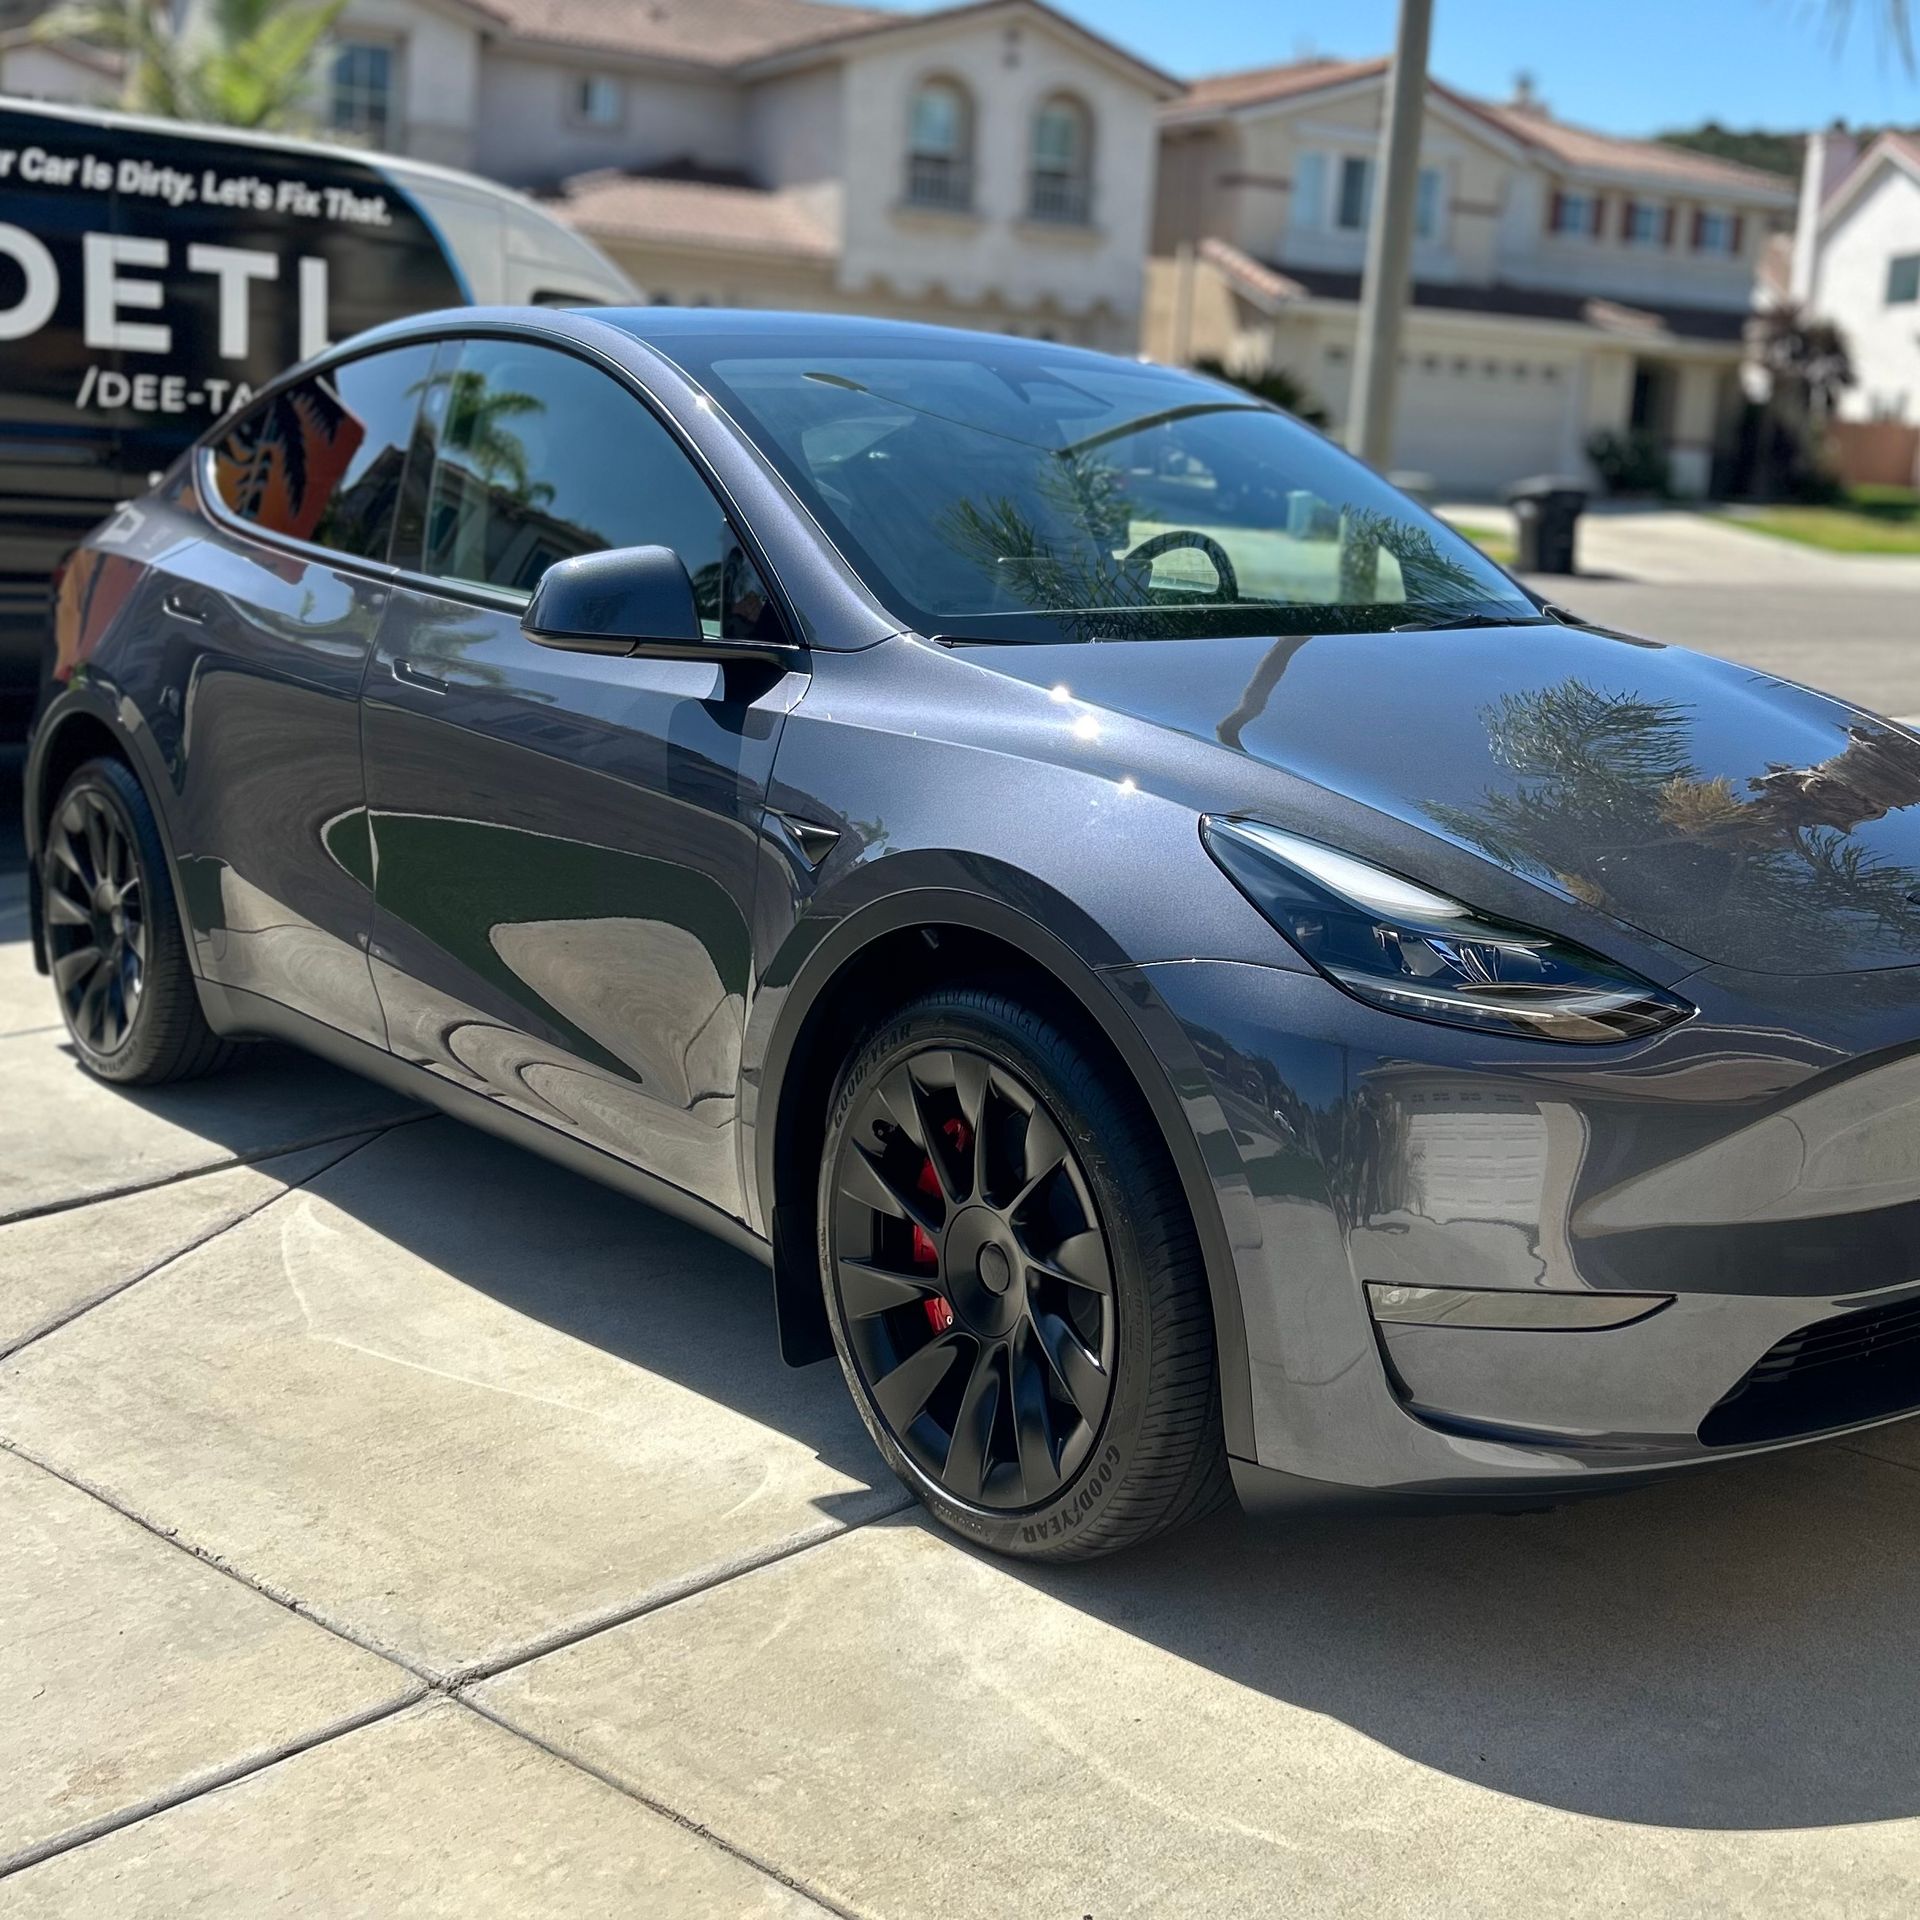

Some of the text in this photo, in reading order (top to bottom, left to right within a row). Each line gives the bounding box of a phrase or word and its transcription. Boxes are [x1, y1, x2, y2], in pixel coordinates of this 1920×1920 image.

[19, 146, 80, 186] Car
[81, 153, 114, 191] Is
[117, 159, 197, 207] Dirty.
[201, 169, 275, 211] Let's
[276, 180, 323, 218] Fix
[323, 187, 393, 227] That.
[1022, 1444, 1121, 1544] GOODYEAR
